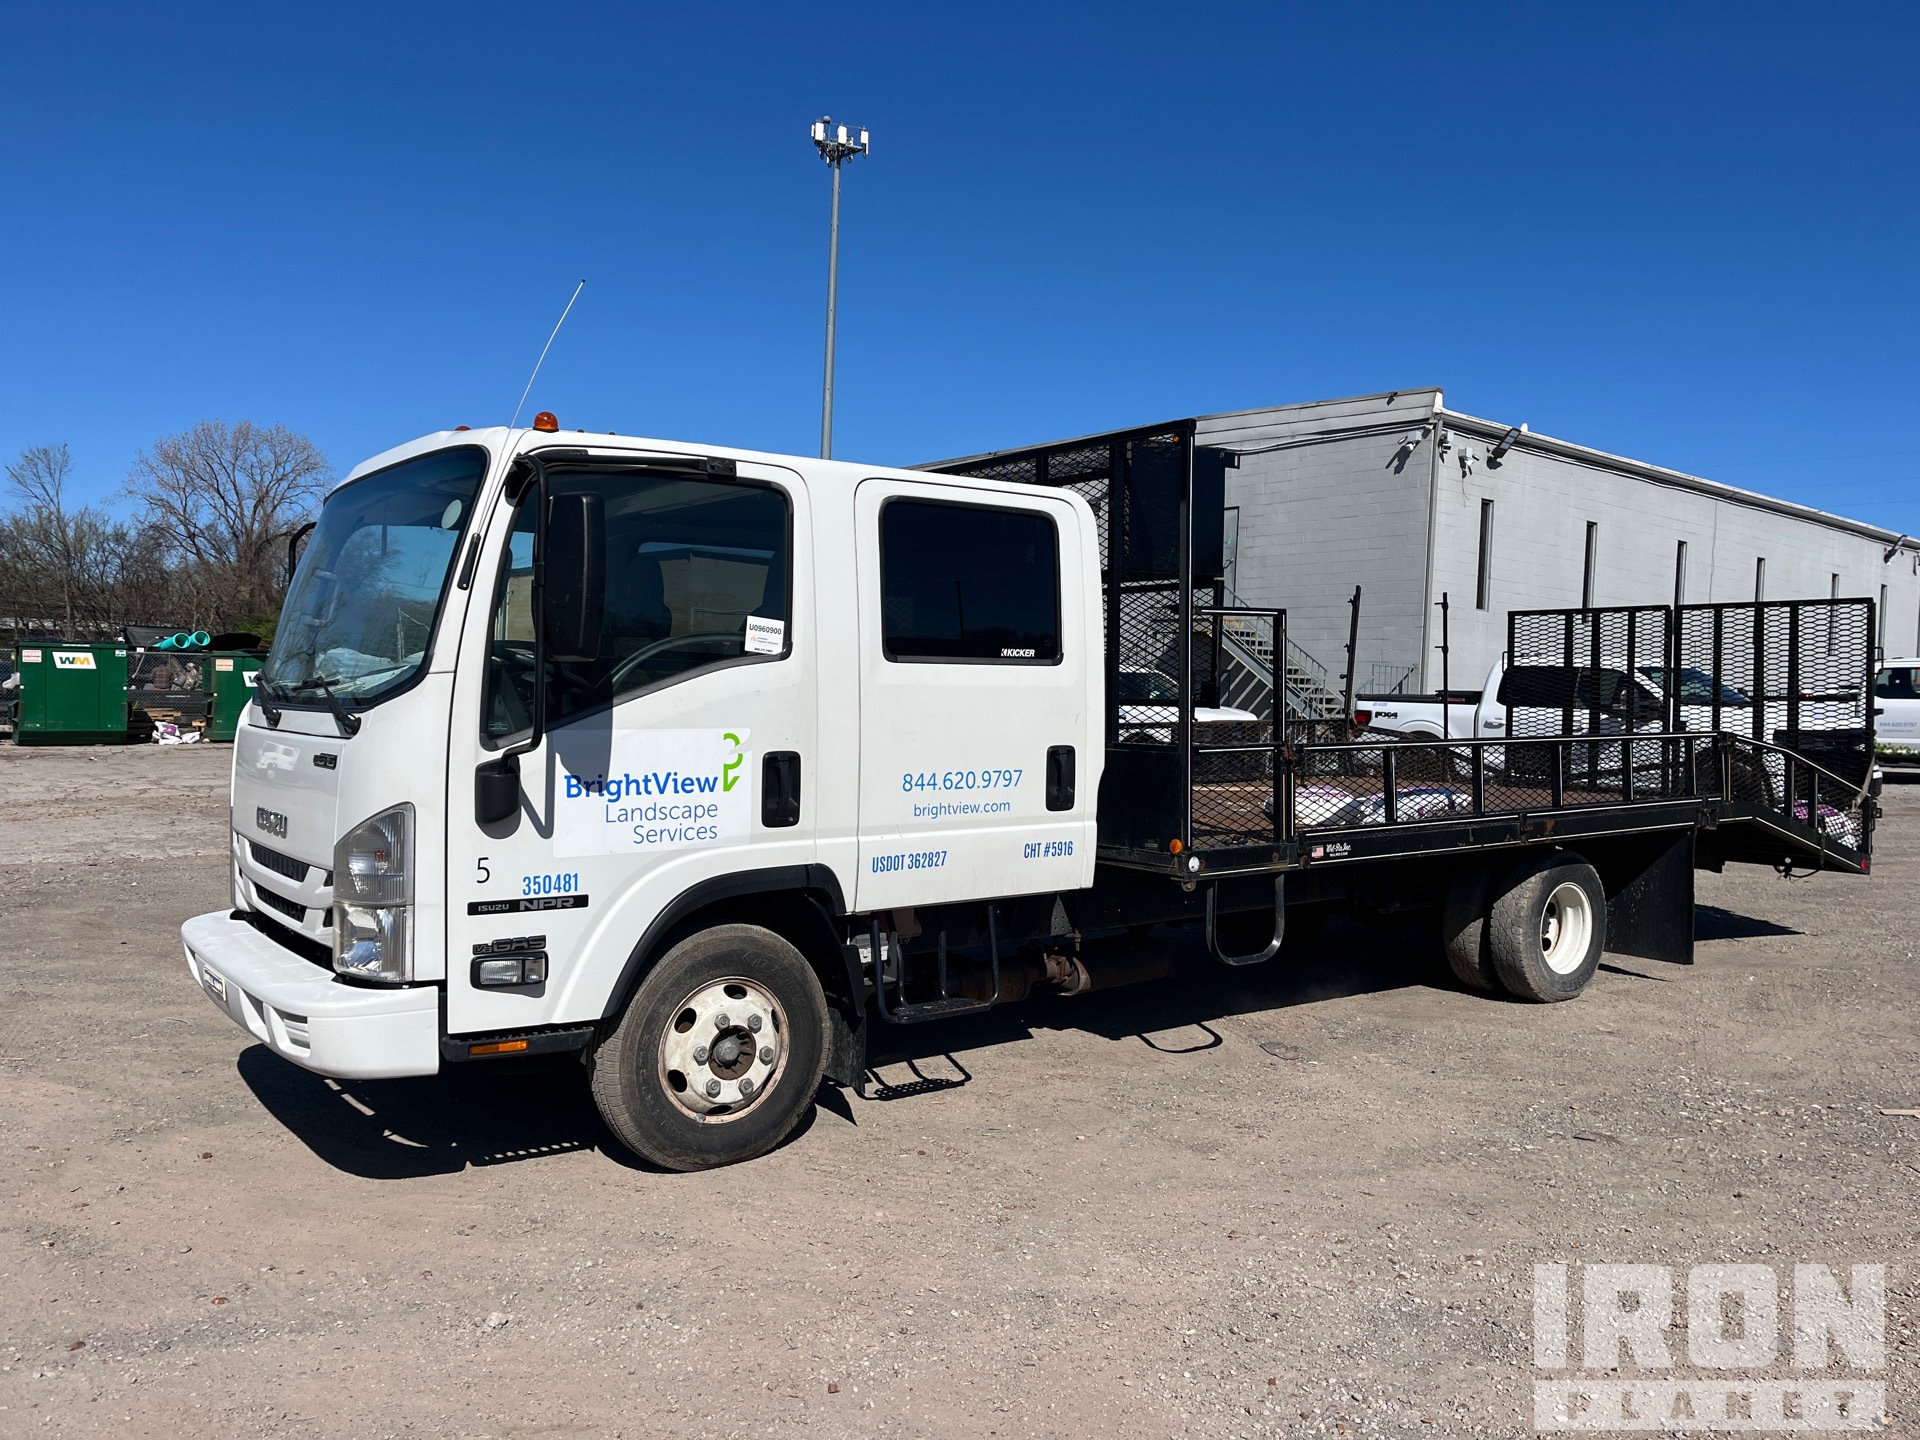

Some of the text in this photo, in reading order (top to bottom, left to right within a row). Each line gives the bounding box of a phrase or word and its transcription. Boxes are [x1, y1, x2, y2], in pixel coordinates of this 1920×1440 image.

[59, 656, 91, 665] WM
[1007, 649, 1036, 657] KICKER
[1374, 711, 1398, 719] FX4
[564, 772, 719, 803] BrightView
[902, 769, 1023, 792] 844.620.9797
[605, 802, 719, 824] Landscape
[913, 801, 1011, 820] brightview.com
[633, 823, 719, 844] Services
[1023, 841, 1074, 859] CHT #5916
[476, 857, 490, 884] 5
[871, 850, 948, 873] USDOT 362827
[522, 873, 579, 896] 350481
[478, 897, 575, 912] ISUZU NPR
